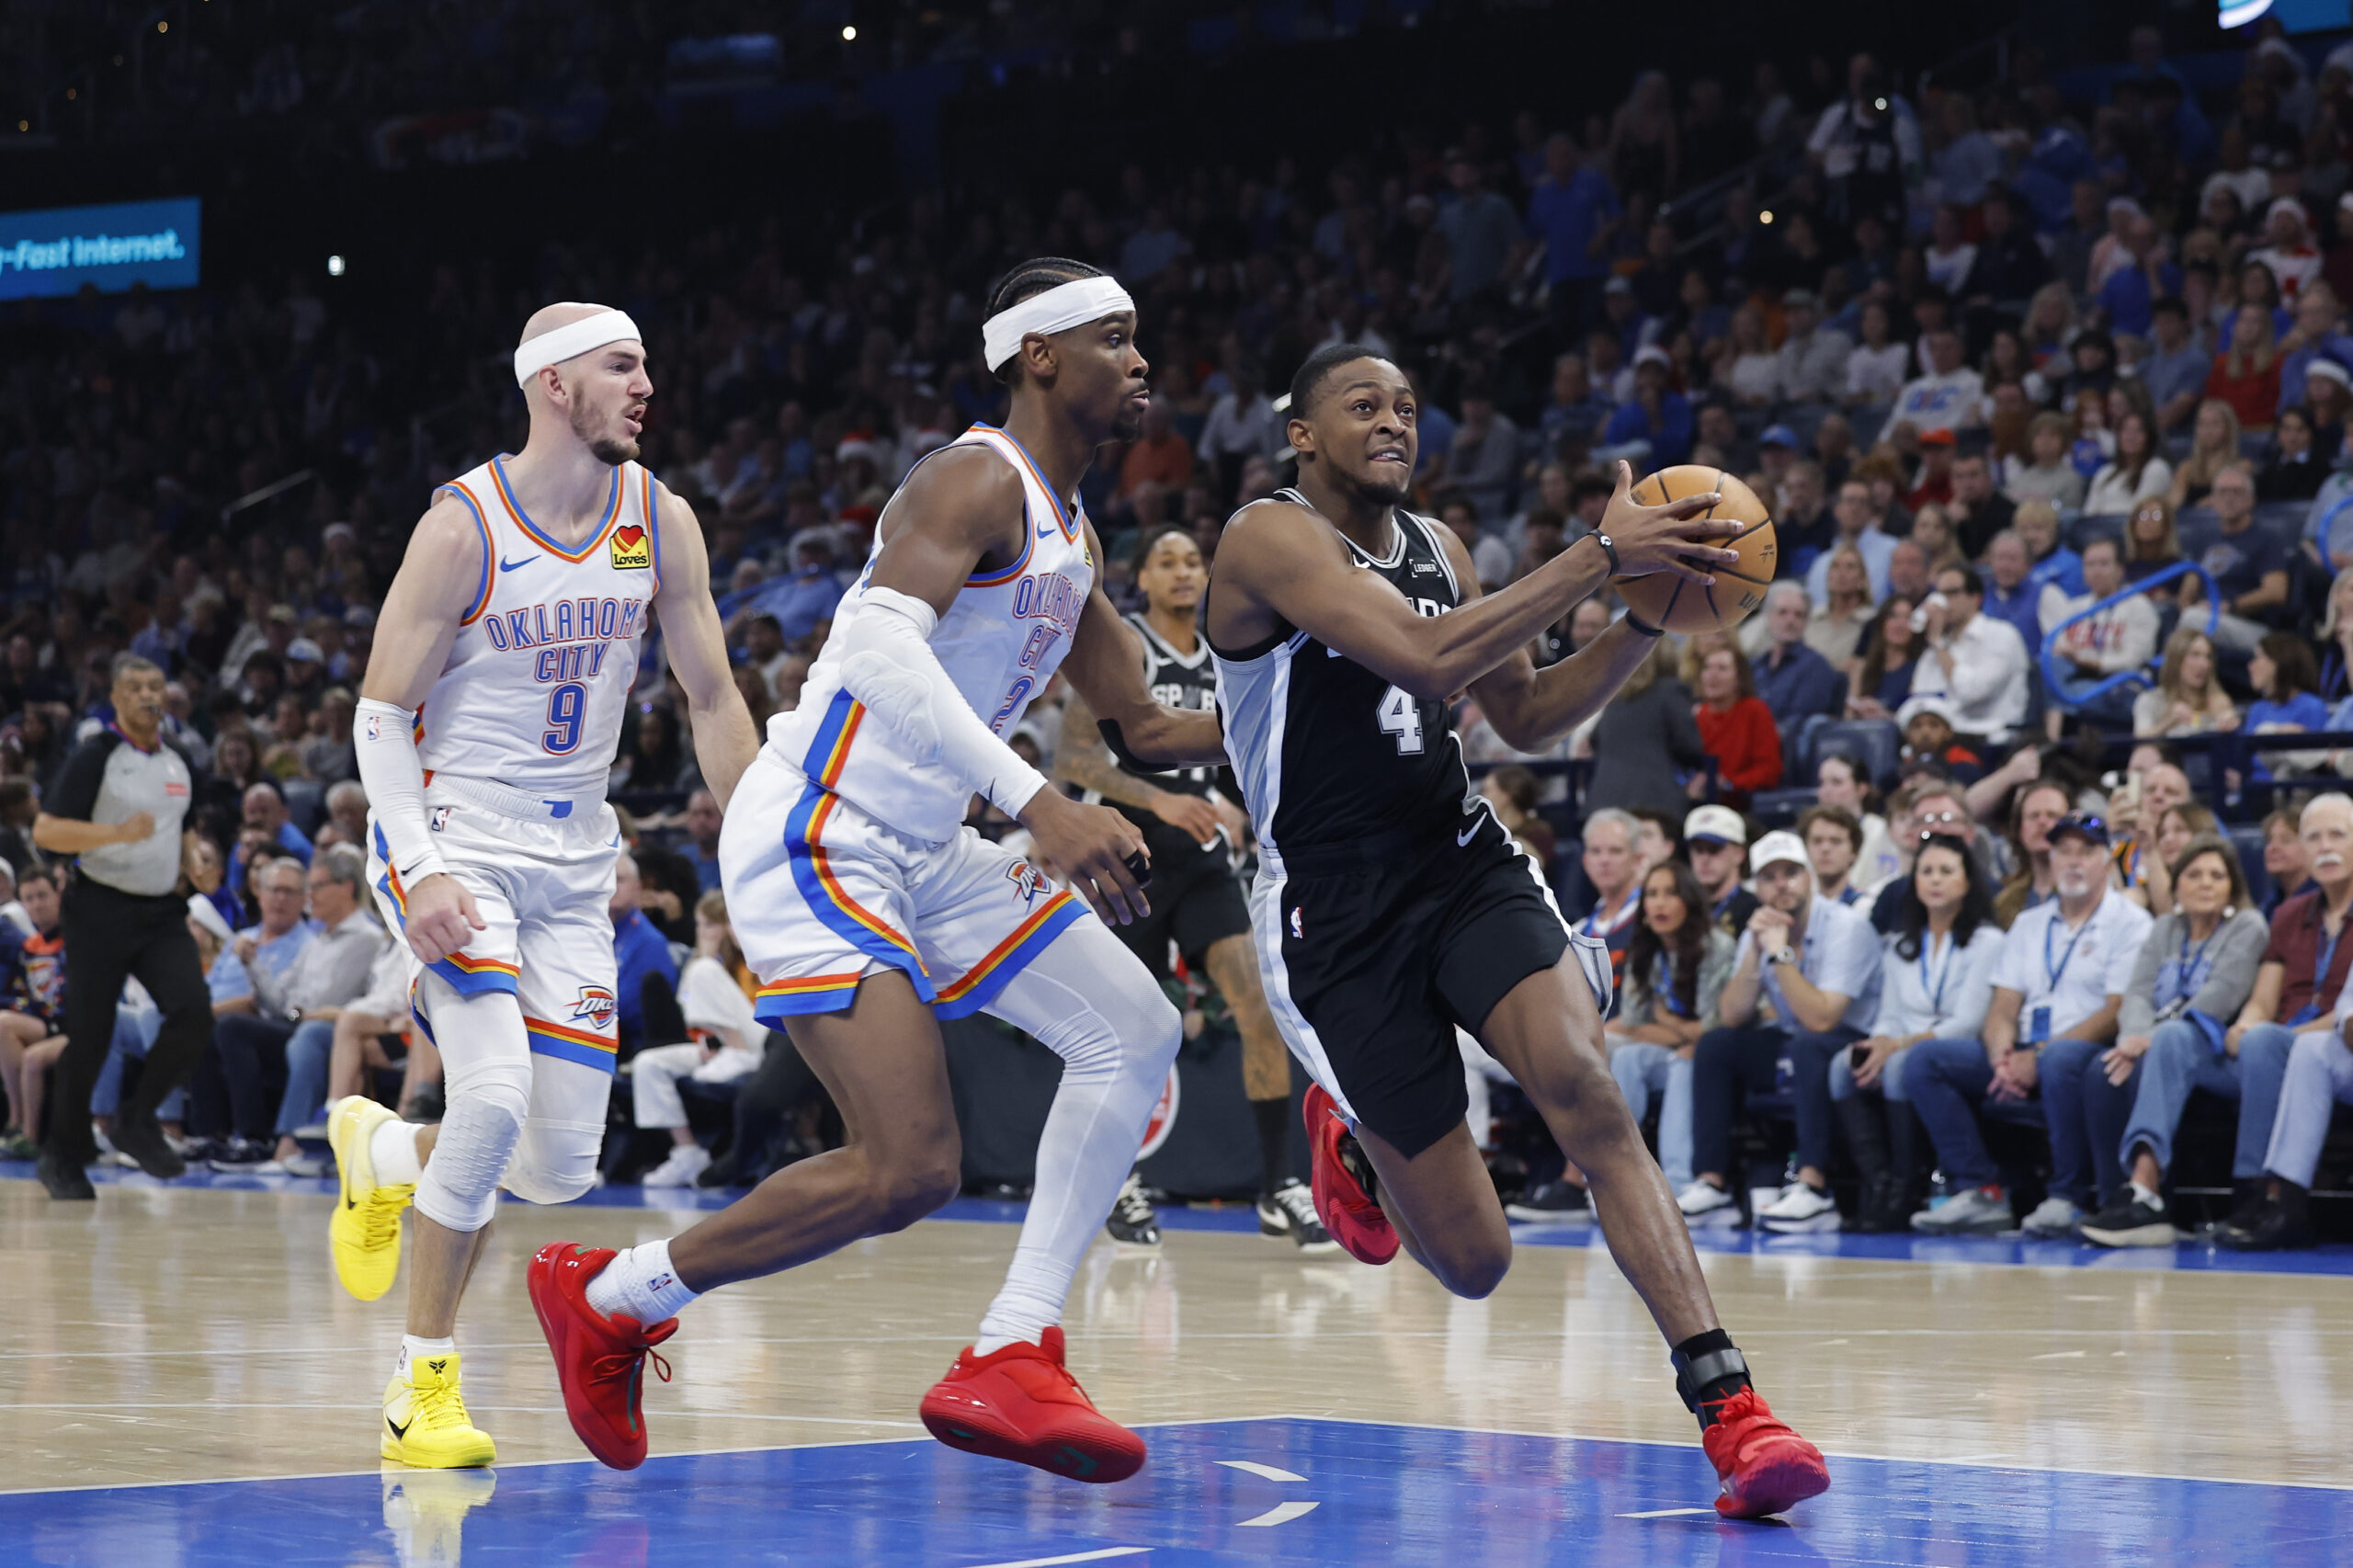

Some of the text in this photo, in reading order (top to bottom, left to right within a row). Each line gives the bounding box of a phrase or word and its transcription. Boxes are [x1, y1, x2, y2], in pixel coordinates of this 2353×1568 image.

[73, 228, 185, 267] Internet.
[1414, 563, 1438, 573] LEDGER
[483, 597, 642, 652] OKLAHOM
[1012, 573, 1083, 639] OKLAHOM
[534, 641, 610, 682] CITY
[541, 681, 587, 756] 9
[1376, 684, 1425, 756] 4
